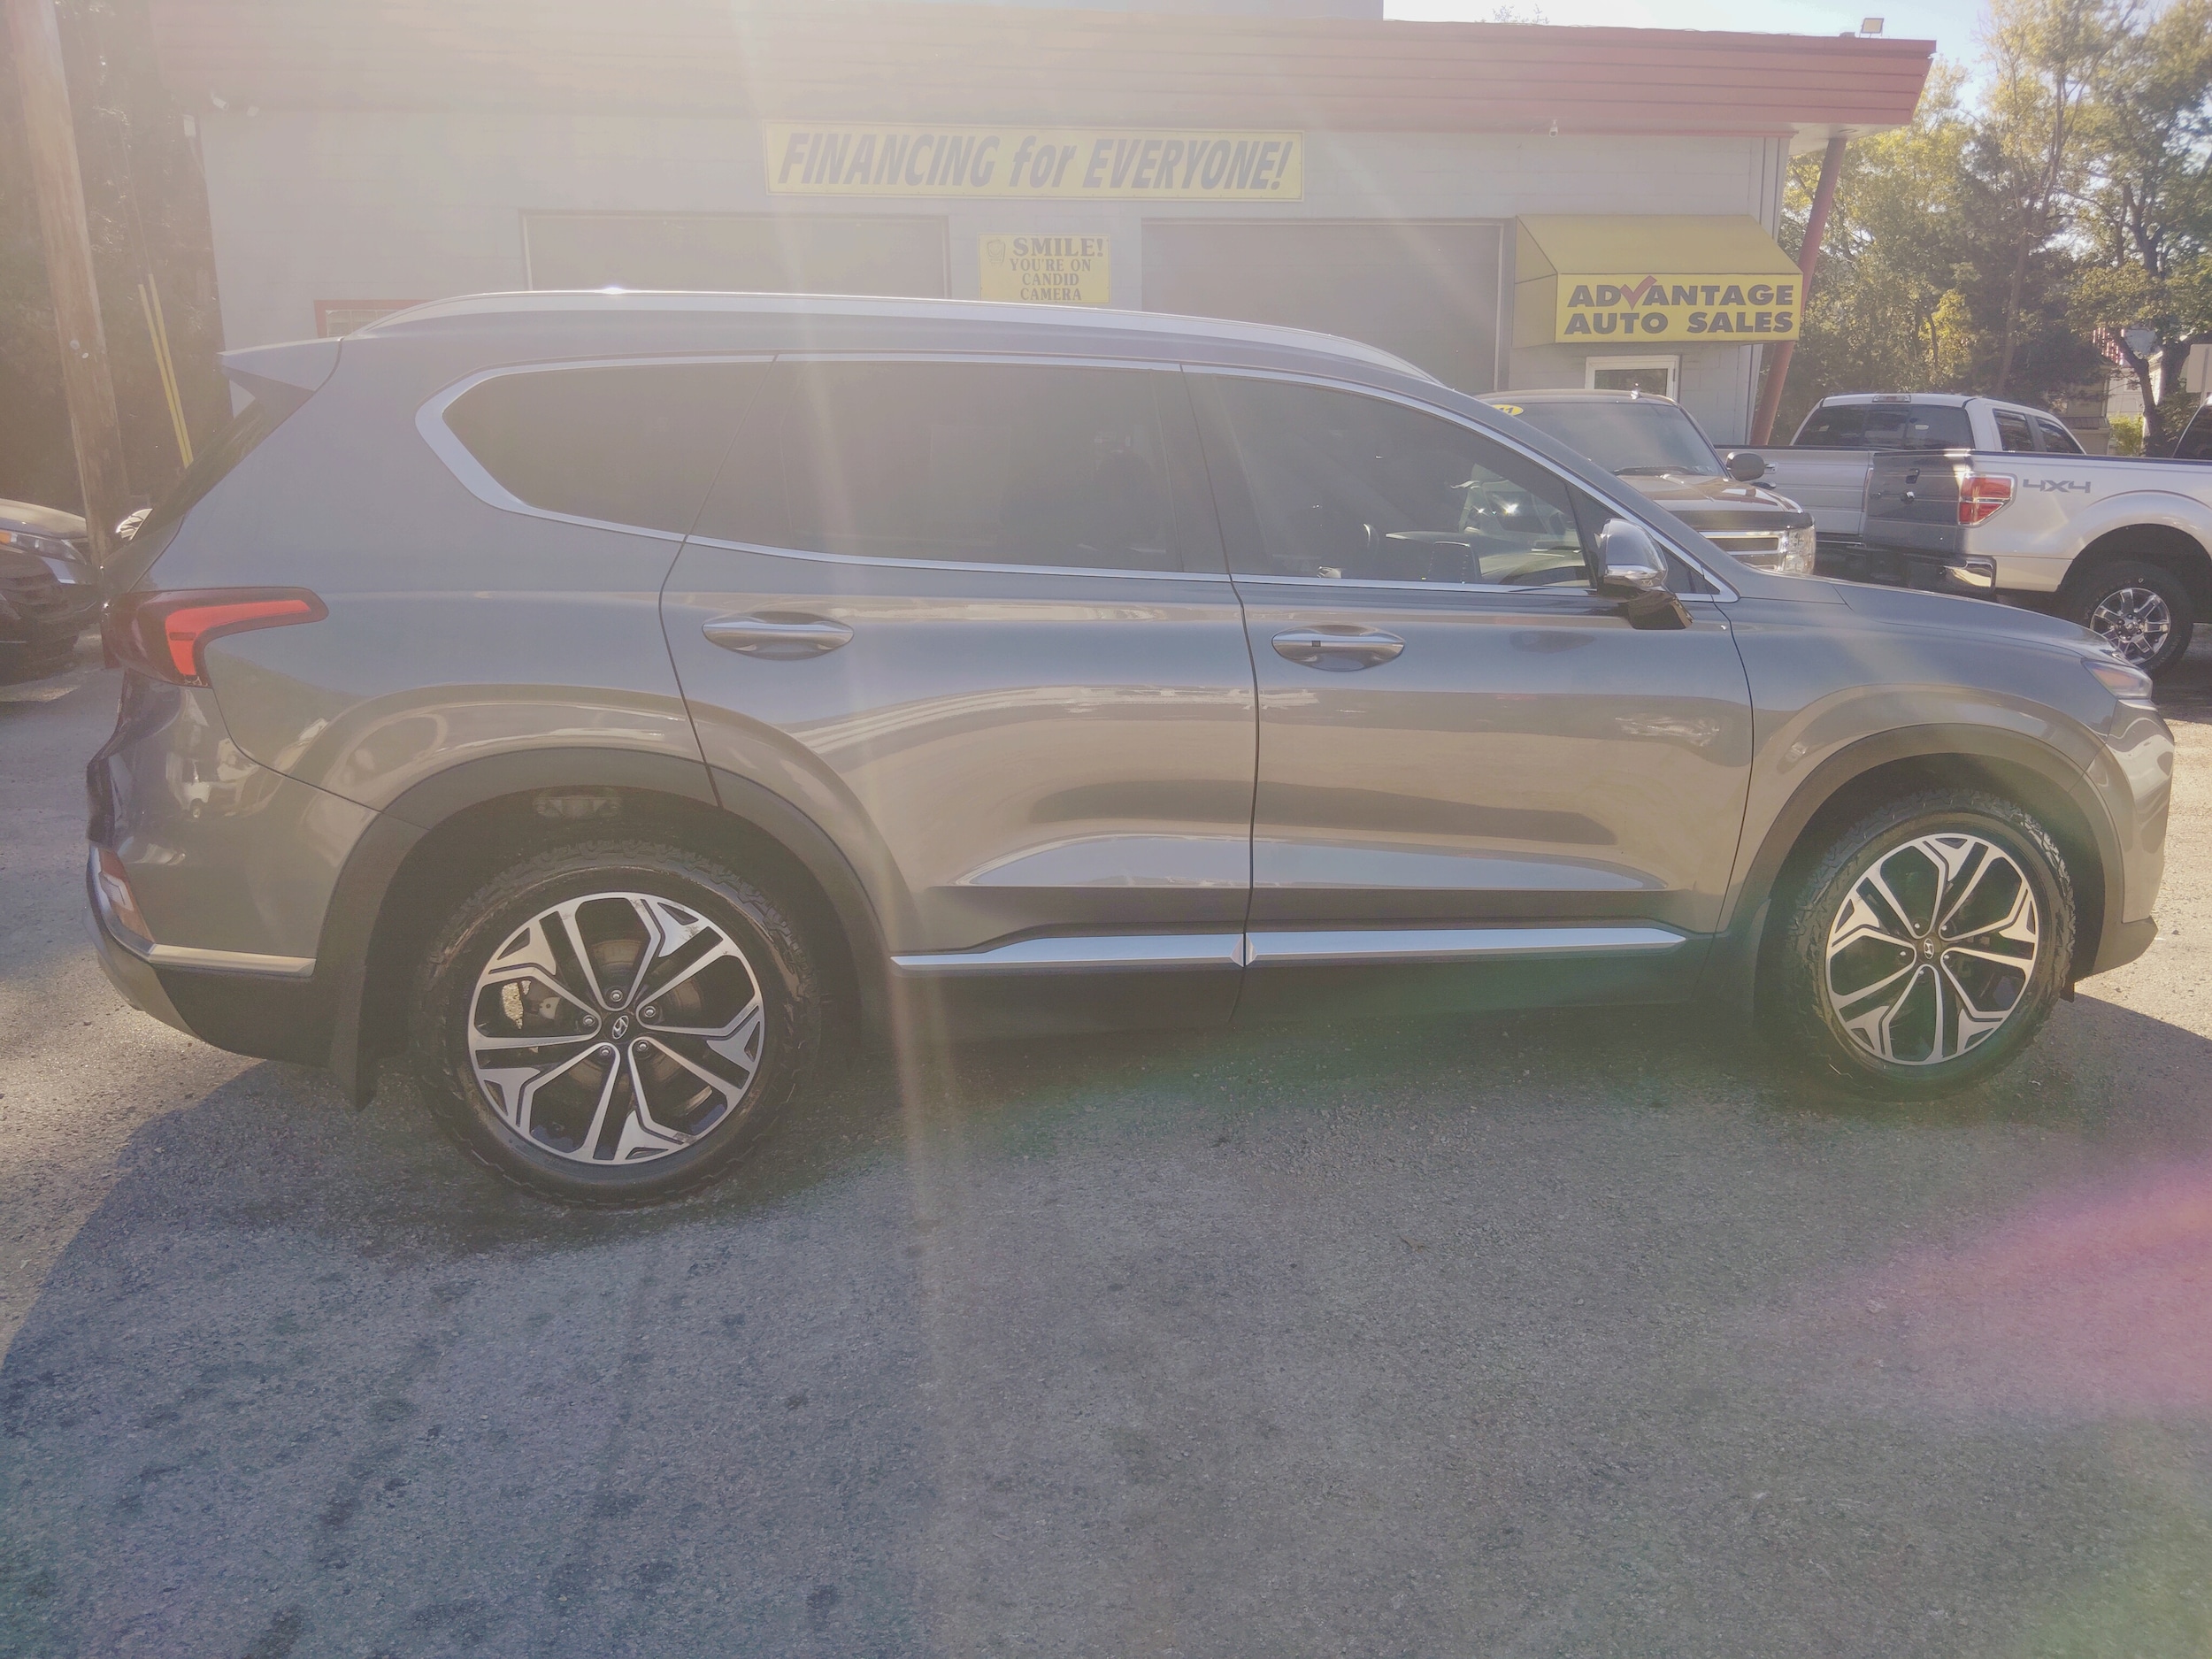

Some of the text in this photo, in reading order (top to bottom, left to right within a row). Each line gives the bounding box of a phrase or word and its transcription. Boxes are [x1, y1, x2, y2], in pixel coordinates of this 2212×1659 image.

[778, 133, 1294, 191] FINANCING for EVERYONE!
[1013, 237, 1103, 257] SMILE!
[1010, 259, 1091, 272] YOU'RE ON
[1022, 273, 1079, 286] CANDID
[1021, 288, 1082, 301] CAMERA
[1567, 275, 1793, 310] ADVANTAGE
[1563, 311, 1793, 334] AUTO SALES
[2023, 479, 2091, 494] 4X4
